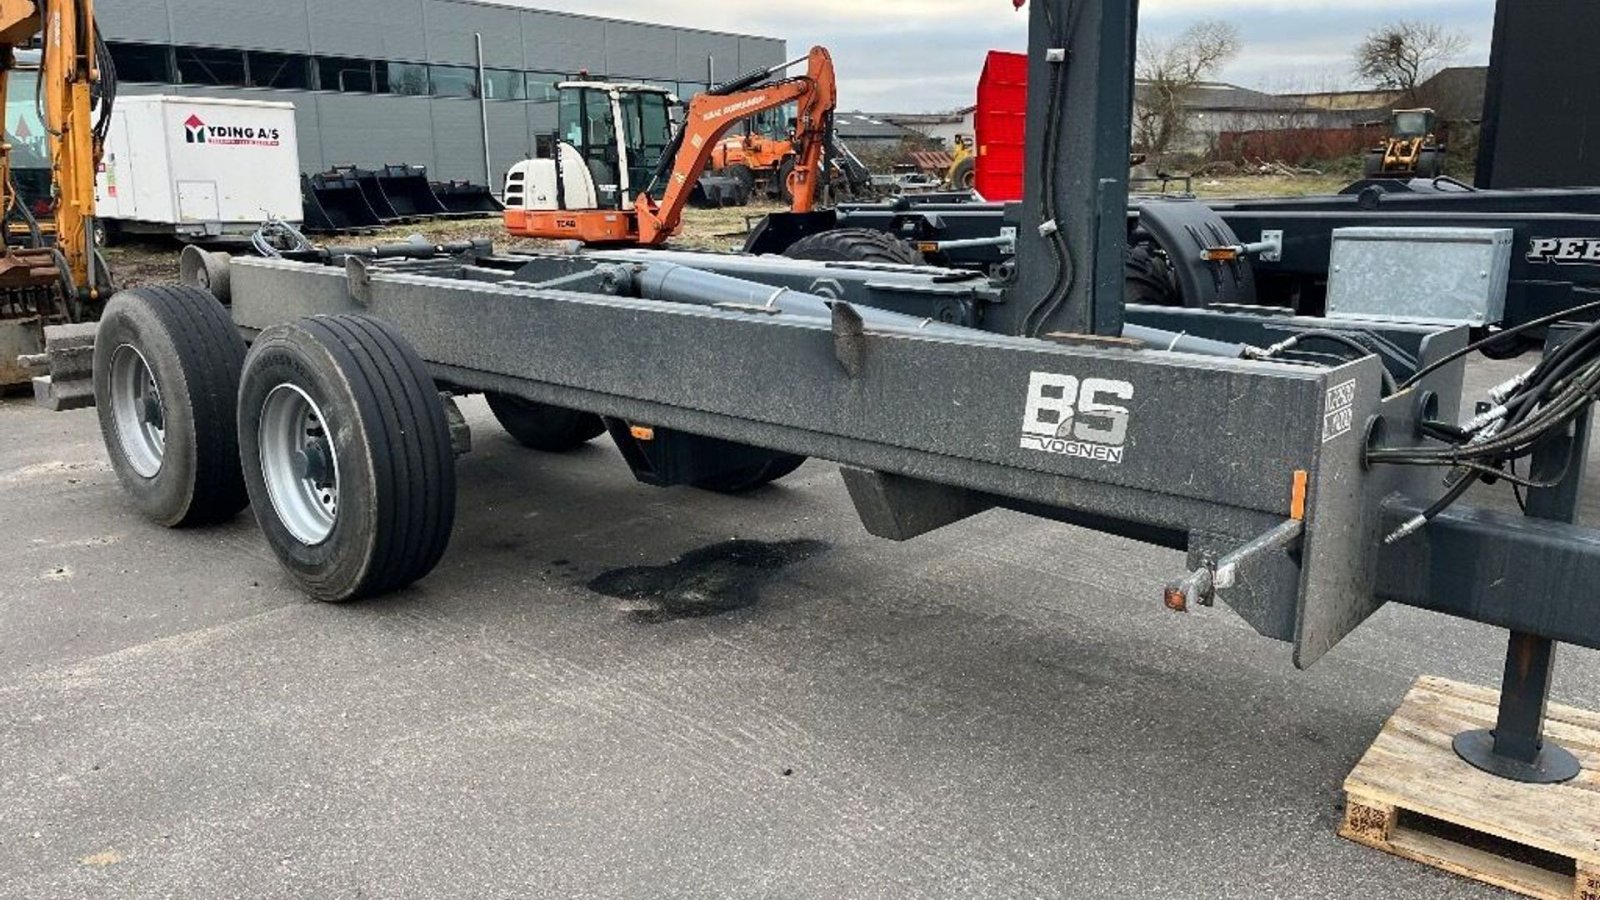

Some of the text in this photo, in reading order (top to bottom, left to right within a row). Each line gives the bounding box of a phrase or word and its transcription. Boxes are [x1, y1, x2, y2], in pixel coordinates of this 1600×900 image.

[207, 126, 280, 140] YDING A/S
[1040, 439, 1121, 462] VOGNEN
